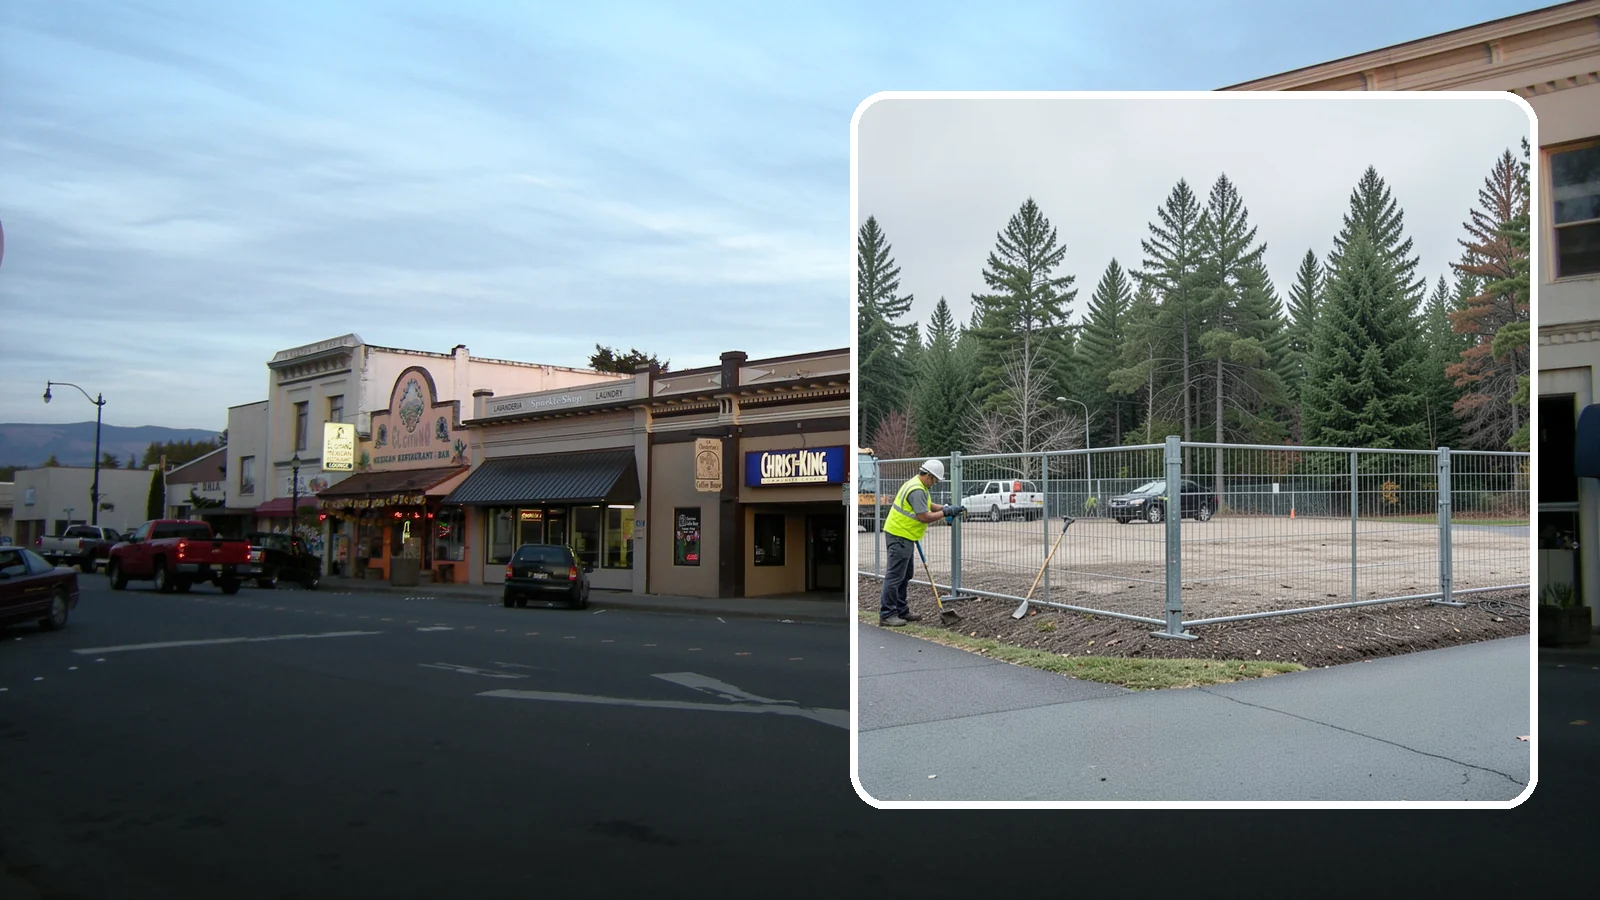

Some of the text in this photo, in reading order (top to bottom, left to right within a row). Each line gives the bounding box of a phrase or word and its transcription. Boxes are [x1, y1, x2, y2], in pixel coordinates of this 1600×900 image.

[530, 394, 582, 409] Sparkle Shop
[595, 389, 624, 400] LAUNDRY
[493, 402, 523, 413] LAVANDERIA
[373, 450, 450, 464] MEXICAN RESTAURANT BAR
[761, 450, 827, 477] CHRIST KING
